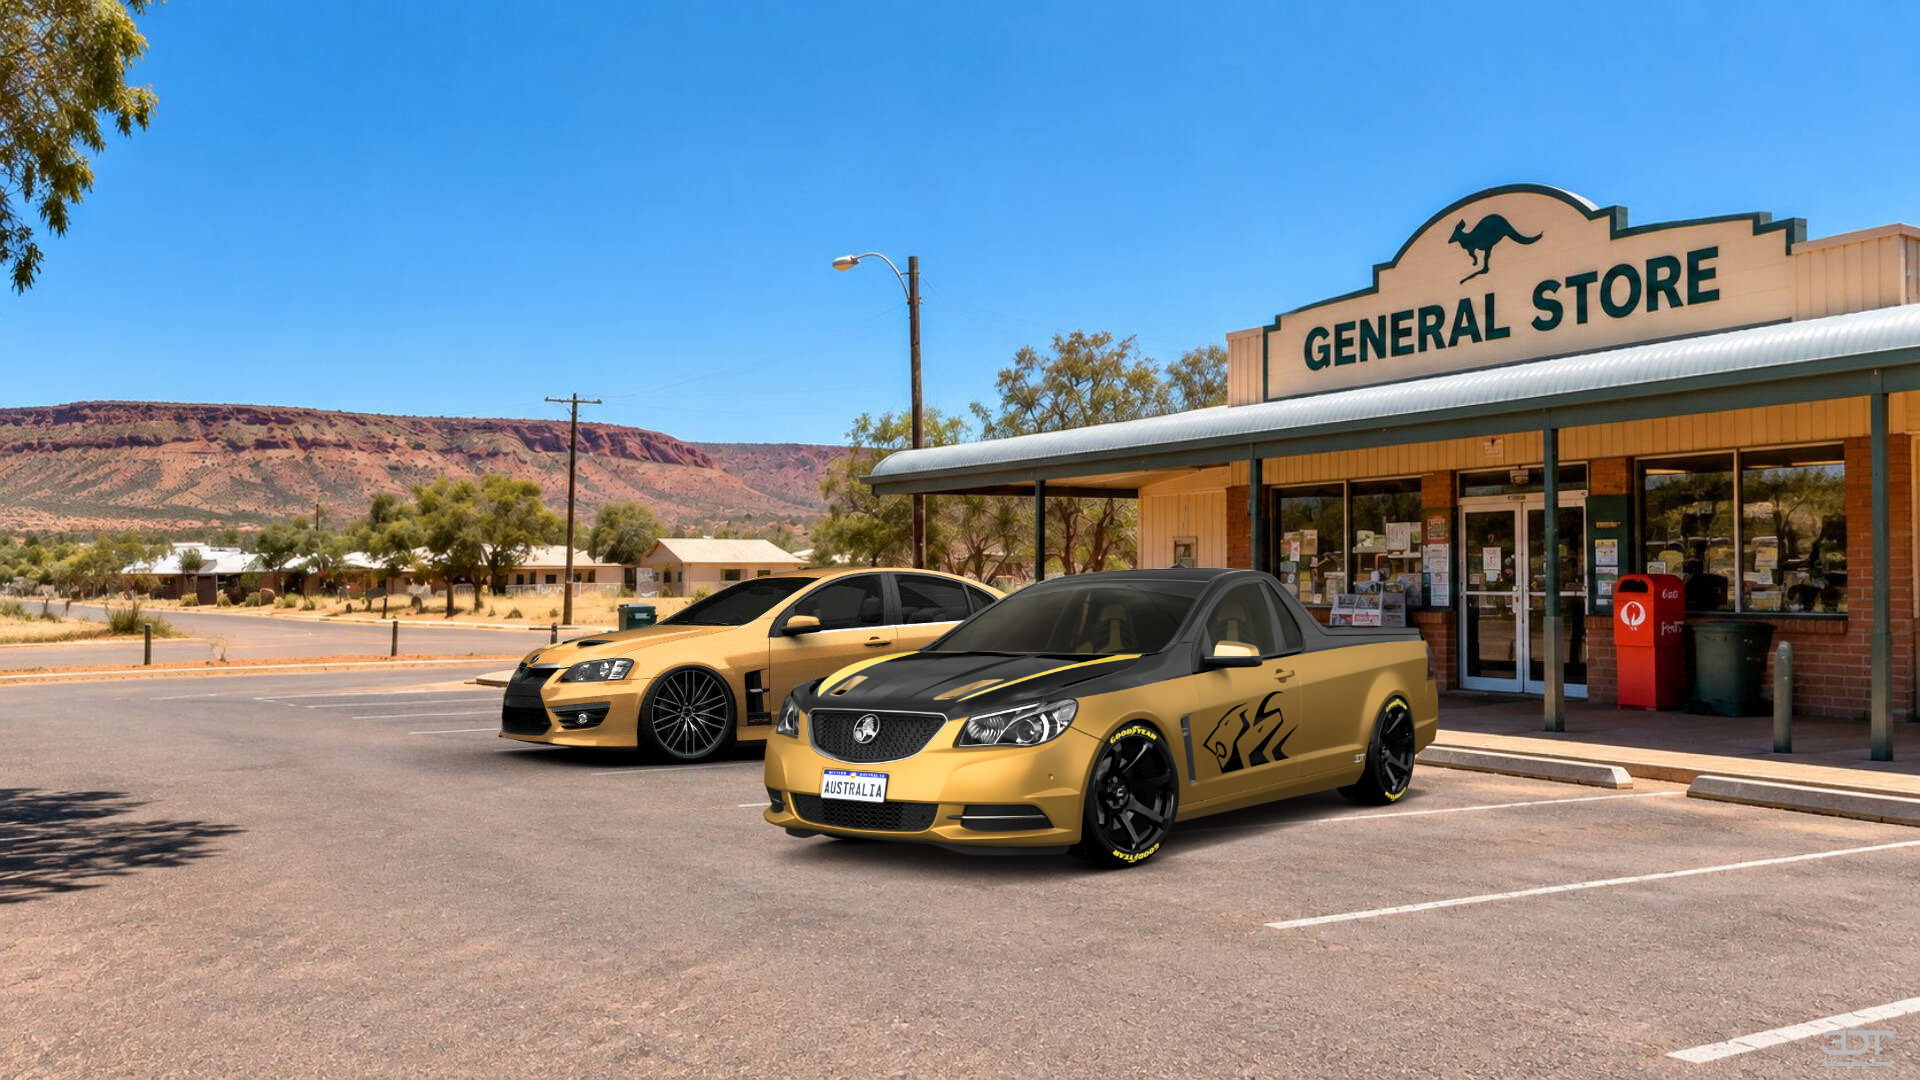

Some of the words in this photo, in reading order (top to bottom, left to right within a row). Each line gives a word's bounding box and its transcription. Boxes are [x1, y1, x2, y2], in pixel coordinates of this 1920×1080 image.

[1303, 292, 1511, 372] GENERAL
[1531, 245, 1721, 332] STORE
[1109, 725, 1158, 744] GOODYEAR
[823, 780, 882, 798] AUSTRALIA
